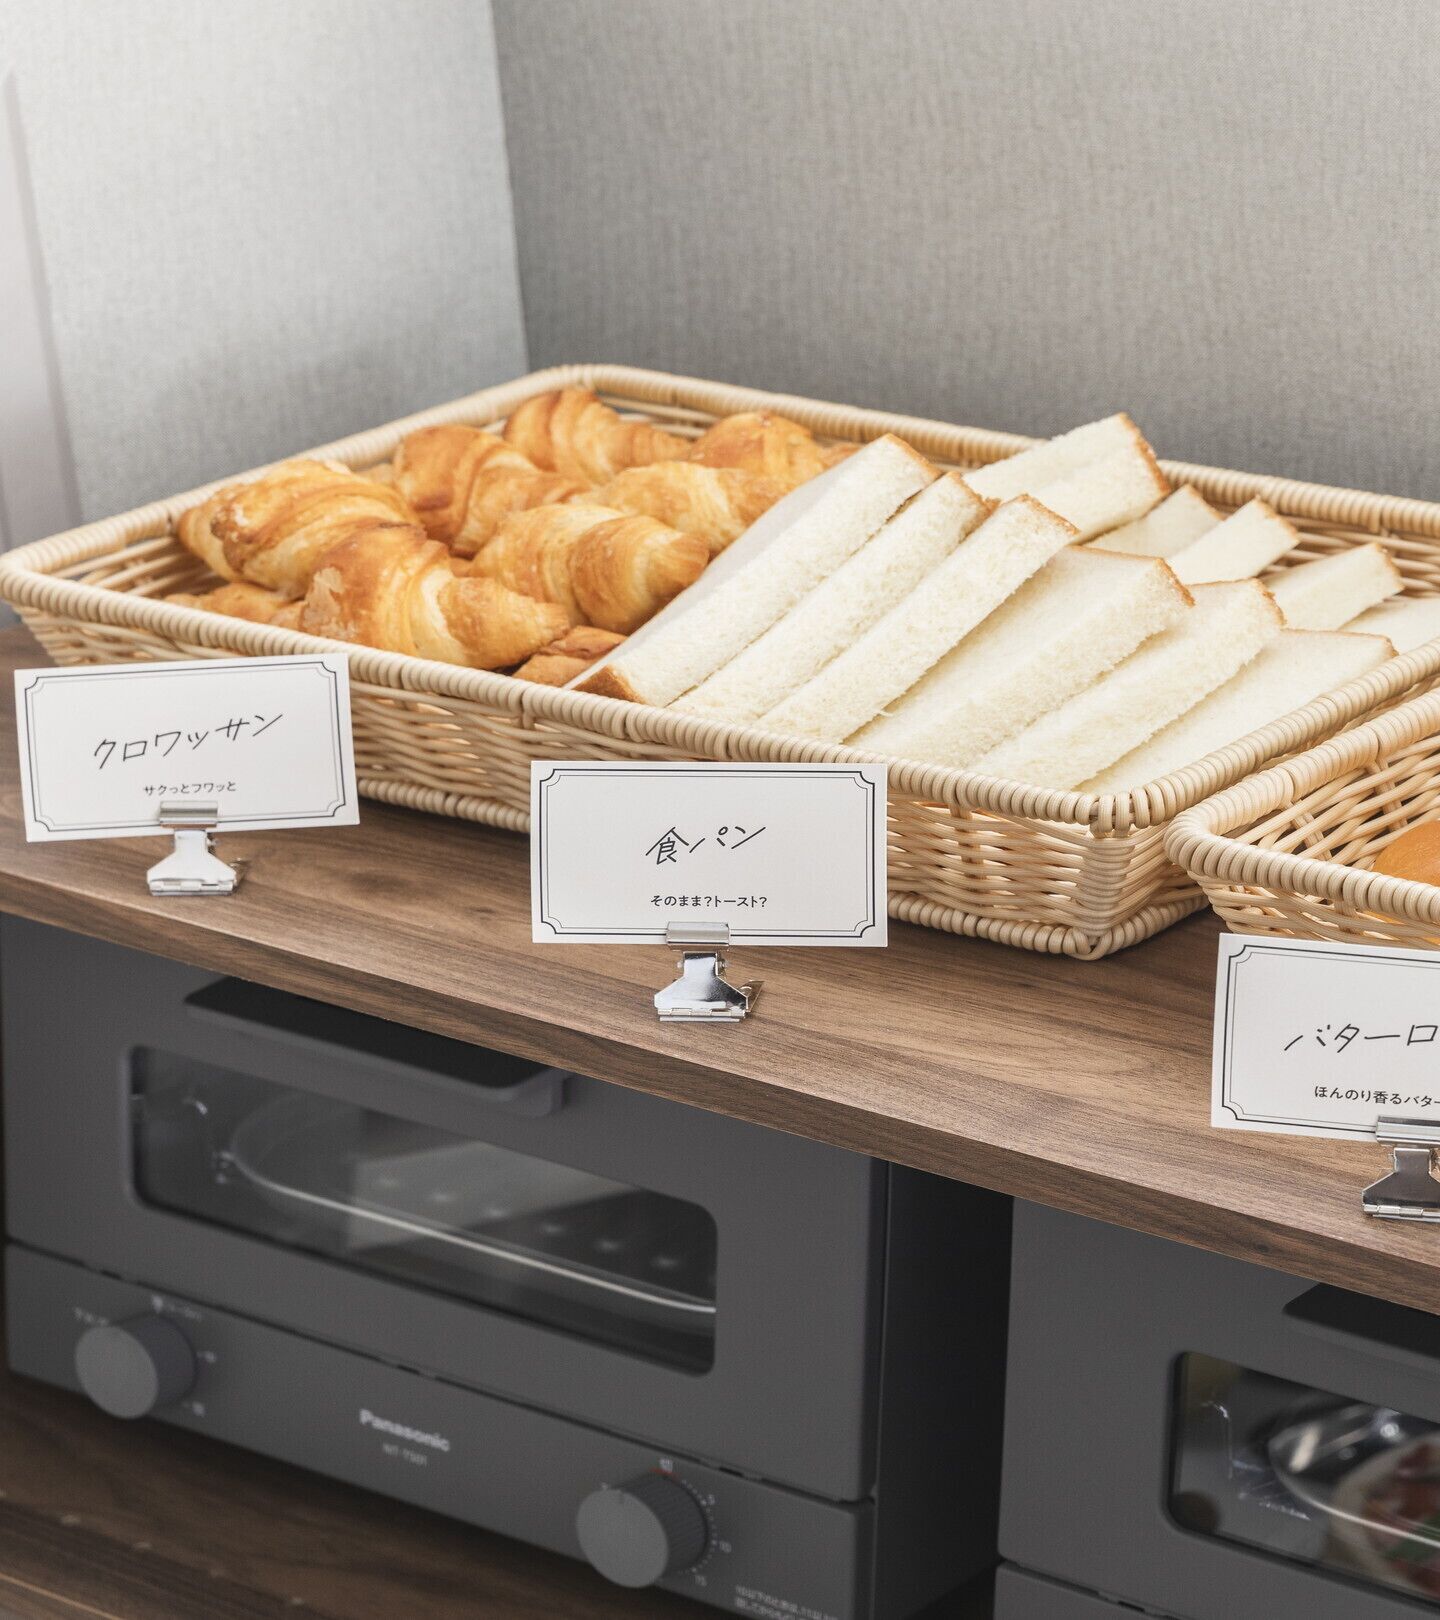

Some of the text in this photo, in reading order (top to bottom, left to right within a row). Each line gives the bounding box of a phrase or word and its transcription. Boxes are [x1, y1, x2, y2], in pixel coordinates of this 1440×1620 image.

[94, 714, 283, 769] クロワッサン
[645, 826, 767, 865] 食パン
[359, 1409, 450, 1453] Panasonic
